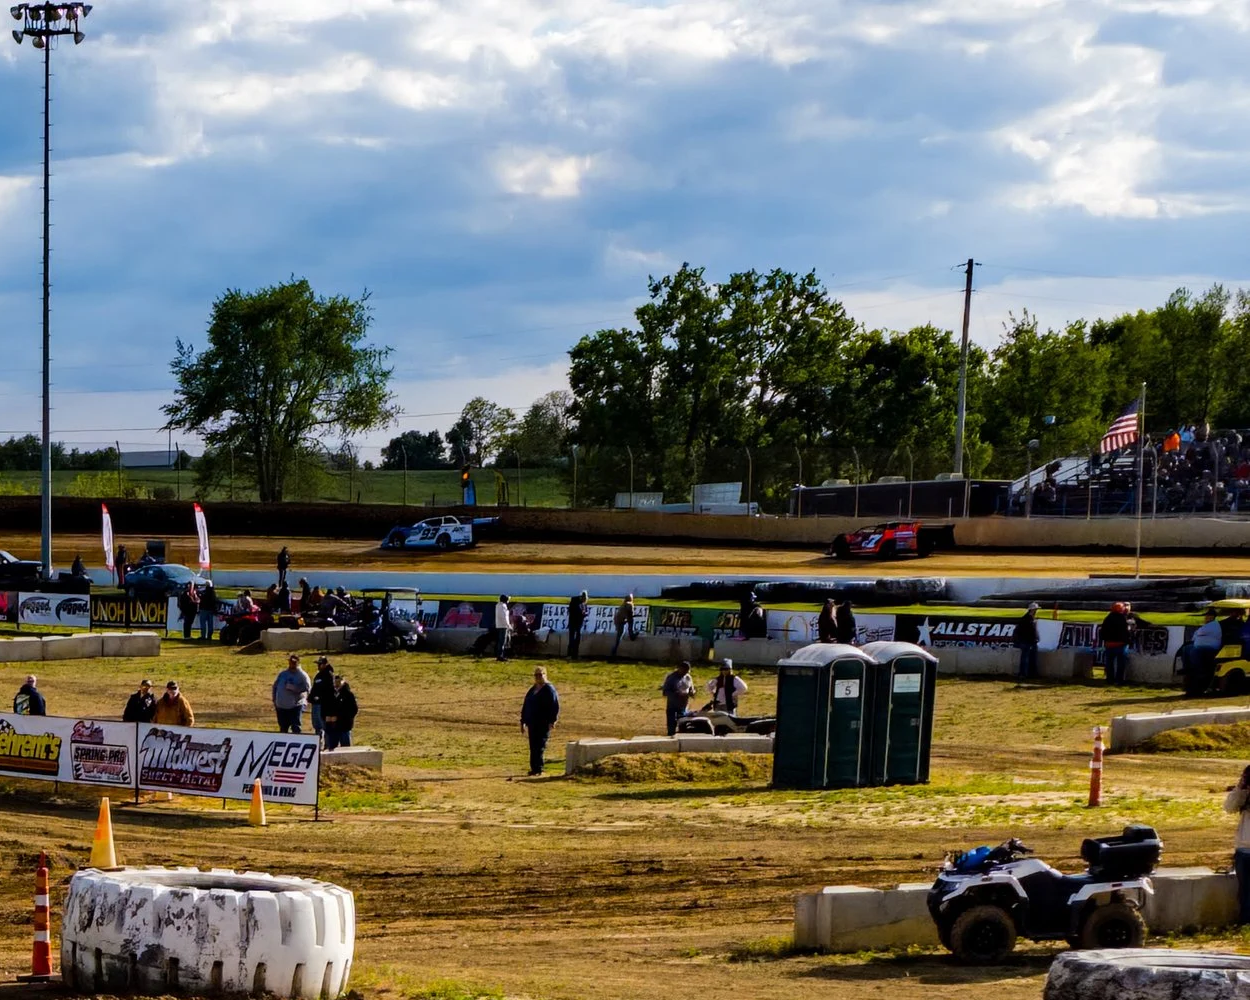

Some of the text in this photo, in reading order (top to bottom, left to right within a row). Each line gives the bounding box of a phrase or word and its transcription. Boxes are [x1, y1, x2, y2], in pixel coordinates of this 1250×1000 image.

[92, 600, 126, 622] UNOH
[129, 601, 167, 623] UNOH
[933, 622, 1016, 637] ALLSTAR
[844, 685, 852, 696] 5
[140, 731, 230, 775] Midwest
[234, 740, 317, 779] MEGA
